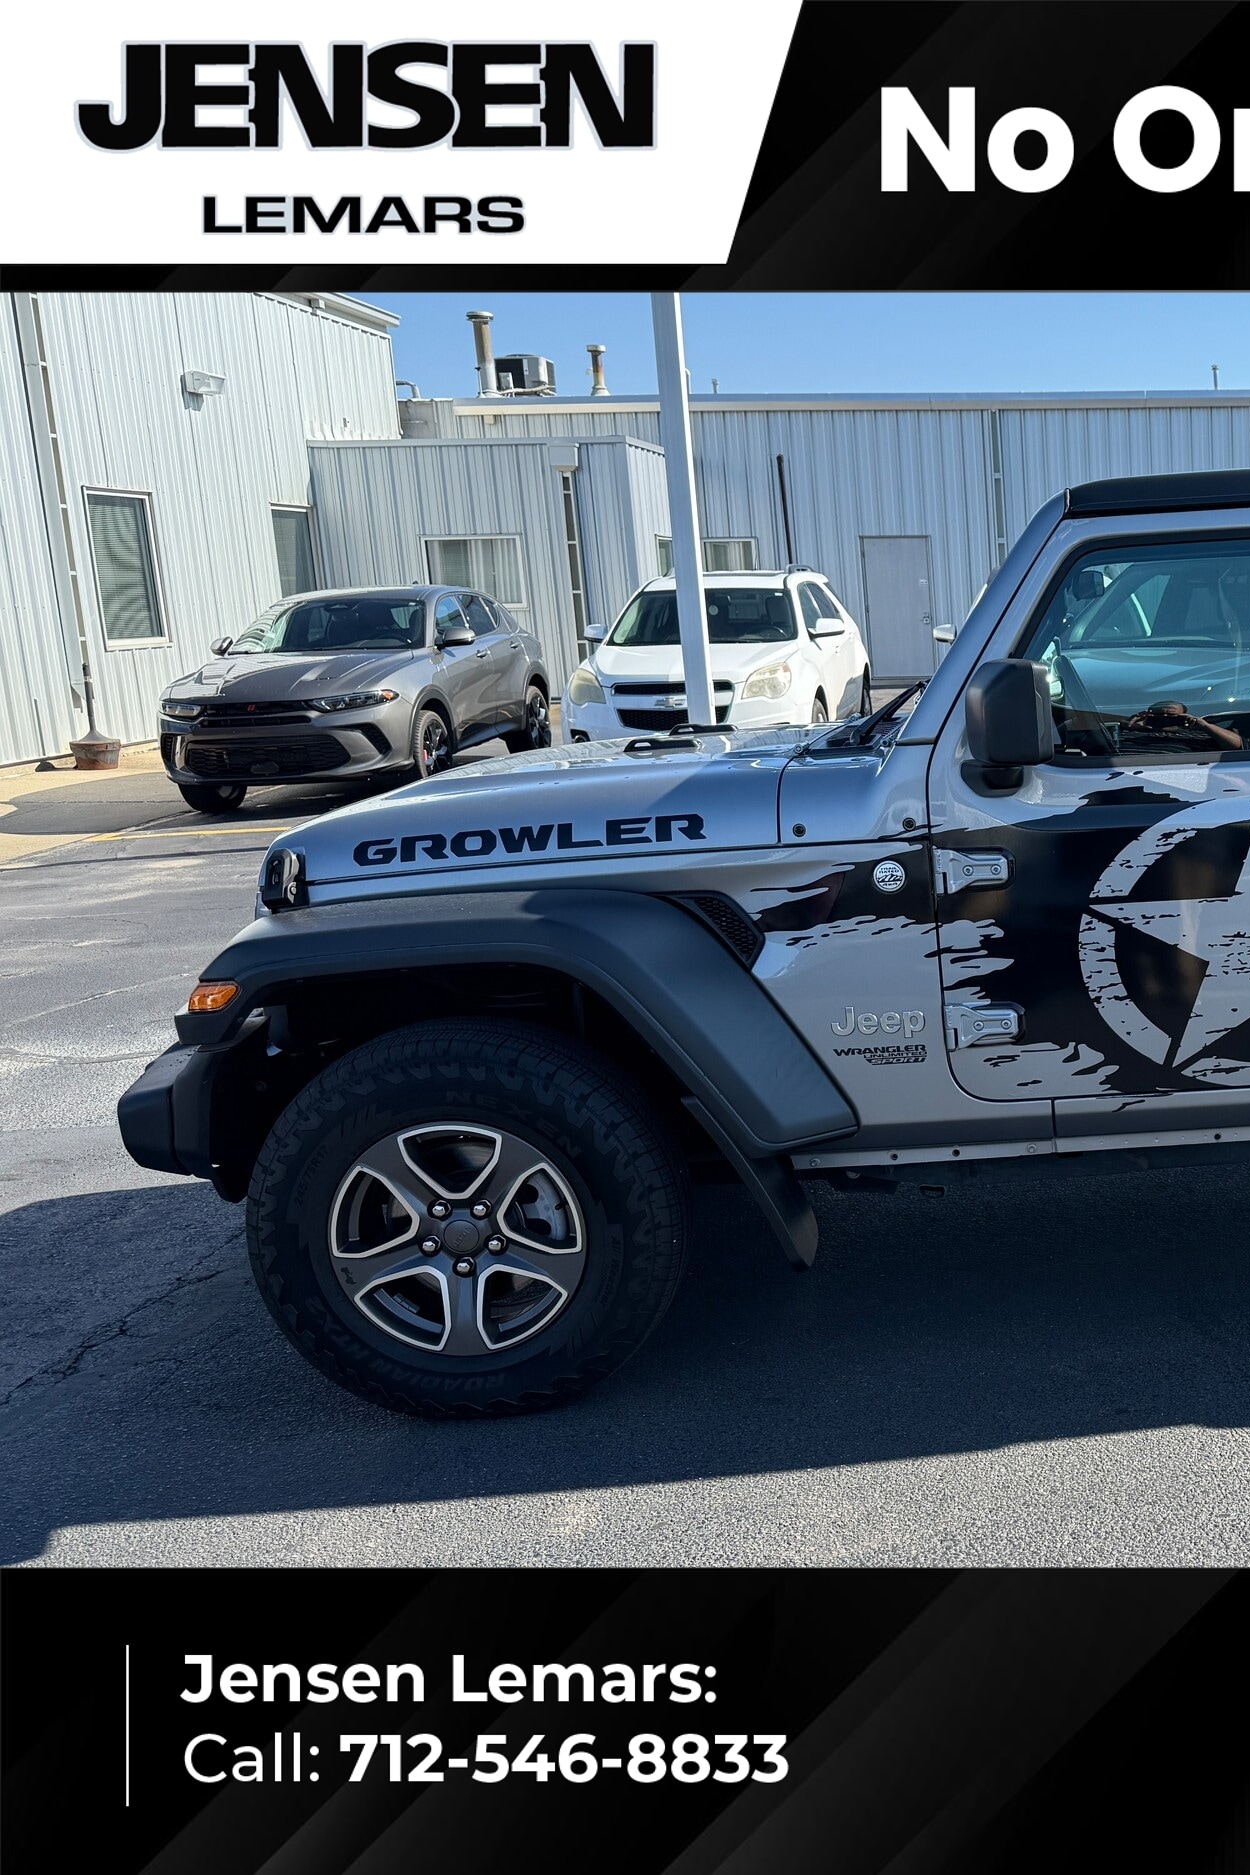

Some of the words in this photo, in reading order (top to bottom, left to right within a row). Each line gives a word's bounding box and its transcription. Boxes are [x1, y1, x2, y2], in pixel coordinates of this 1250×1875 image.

[353, 813, 707, 867] GROWLER
[831, 1006, 926, 1038] Jeep
[833, 1044, 927, 1057] WRANGLER
[863, 1051, 928, 1059] UNLIMITED
[870, 1057, 926, 1065] SPORT
[444, 1090, 583, 1159] NEXEN
[291, 1144, 331, 1206] 245/75R17
